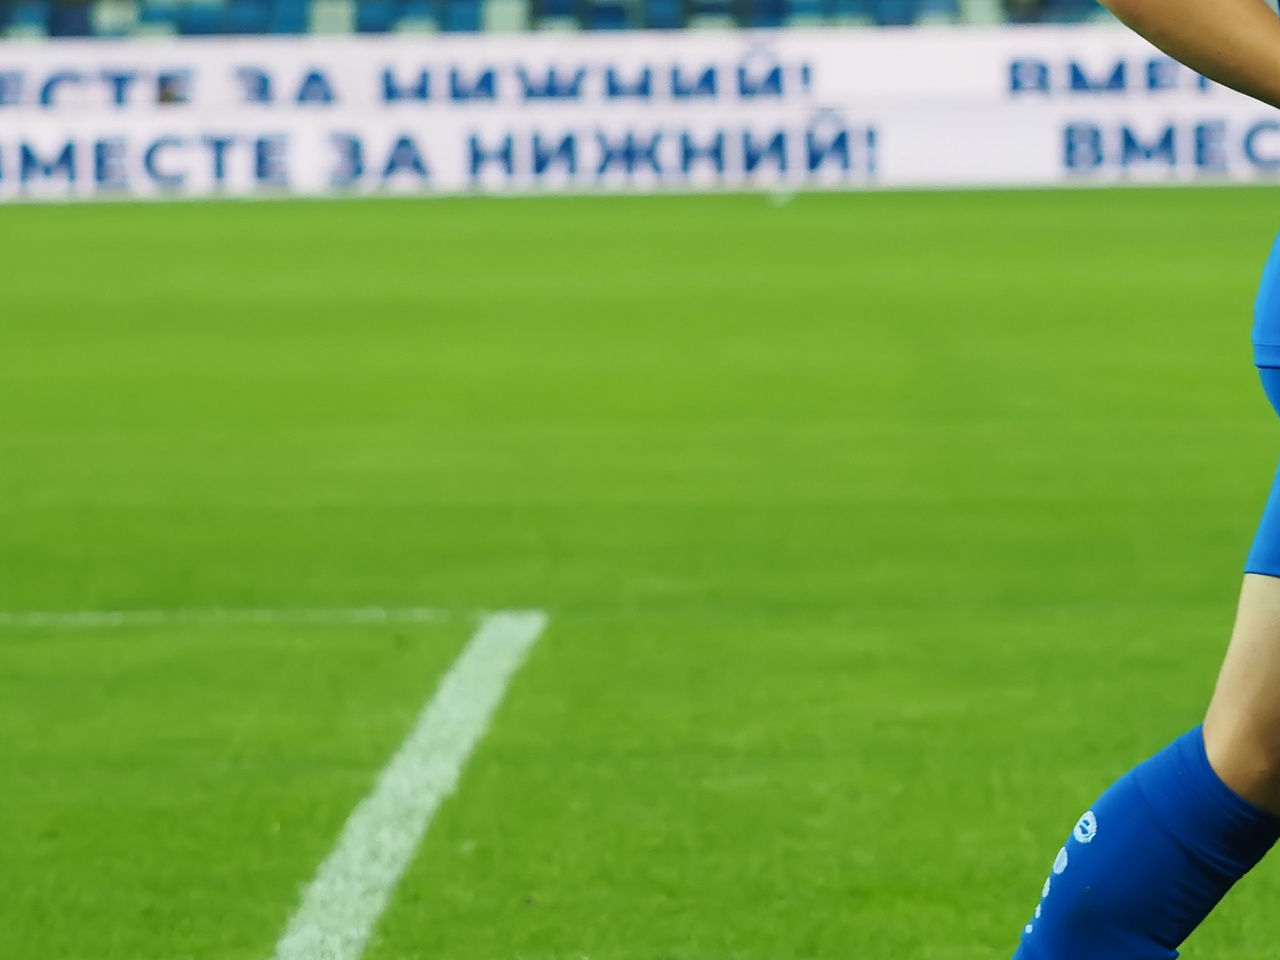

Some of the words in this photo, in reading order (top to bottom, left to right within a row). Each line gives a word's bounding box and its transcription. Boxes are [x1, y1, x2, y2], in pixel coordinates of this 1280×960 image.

[1010, 54, 1211, 92] ВМЕ
[0, 136, 290, 183] МЕСТЕ
[331, 135, 429, 180] ЗА
[469, 110, 876, 176] НИЖНИЙ!
